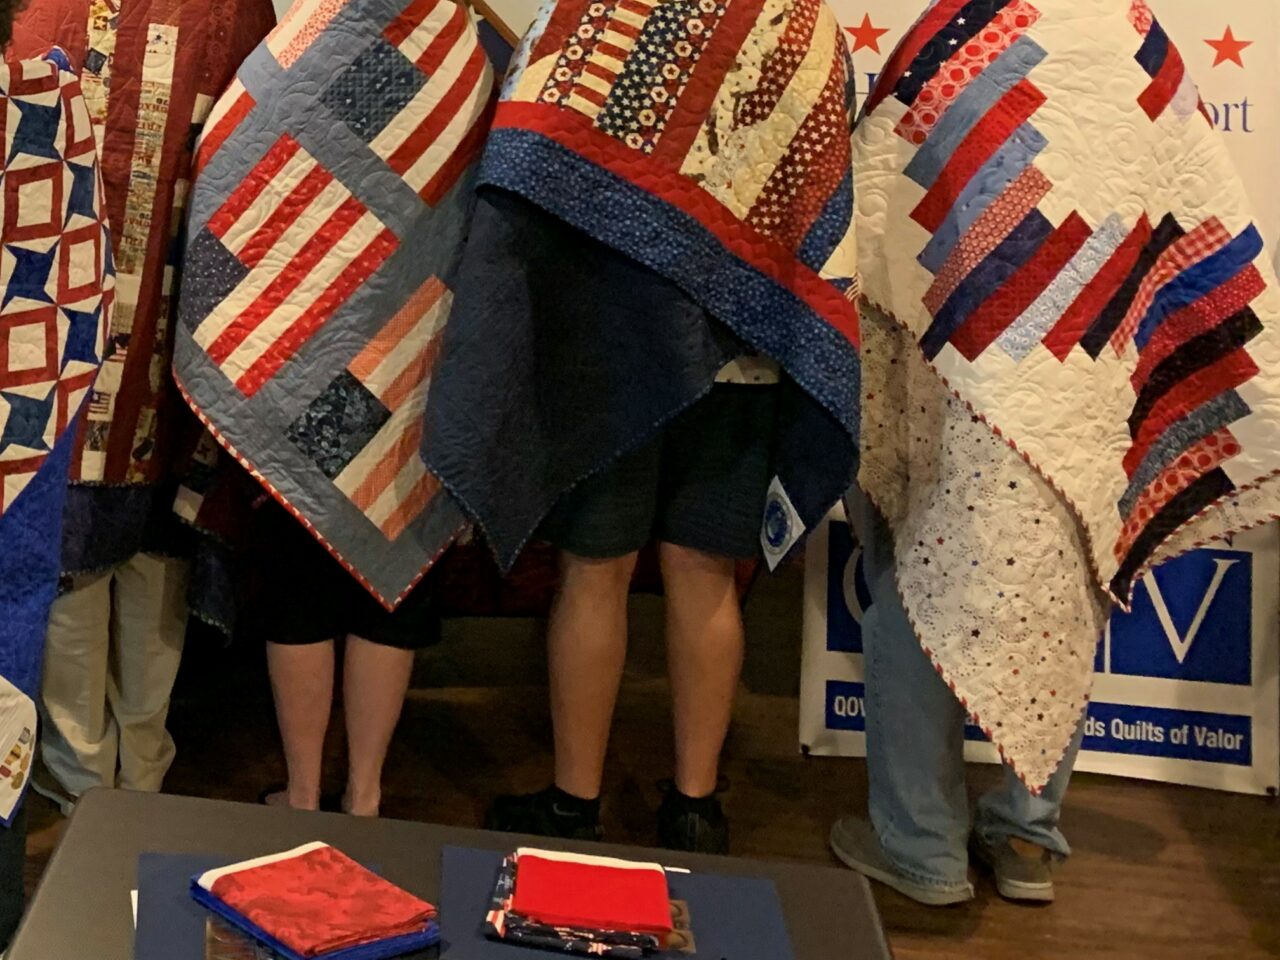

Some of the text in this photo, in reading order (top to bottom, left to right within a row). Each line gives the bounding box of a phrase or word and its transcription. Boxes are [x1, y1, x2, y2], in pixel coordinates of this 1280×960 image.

[1111, 718, 1165, 743] Quilts
[1170, 725, 1189, 745] of
[1194, 725, 1244, 750] Valor
